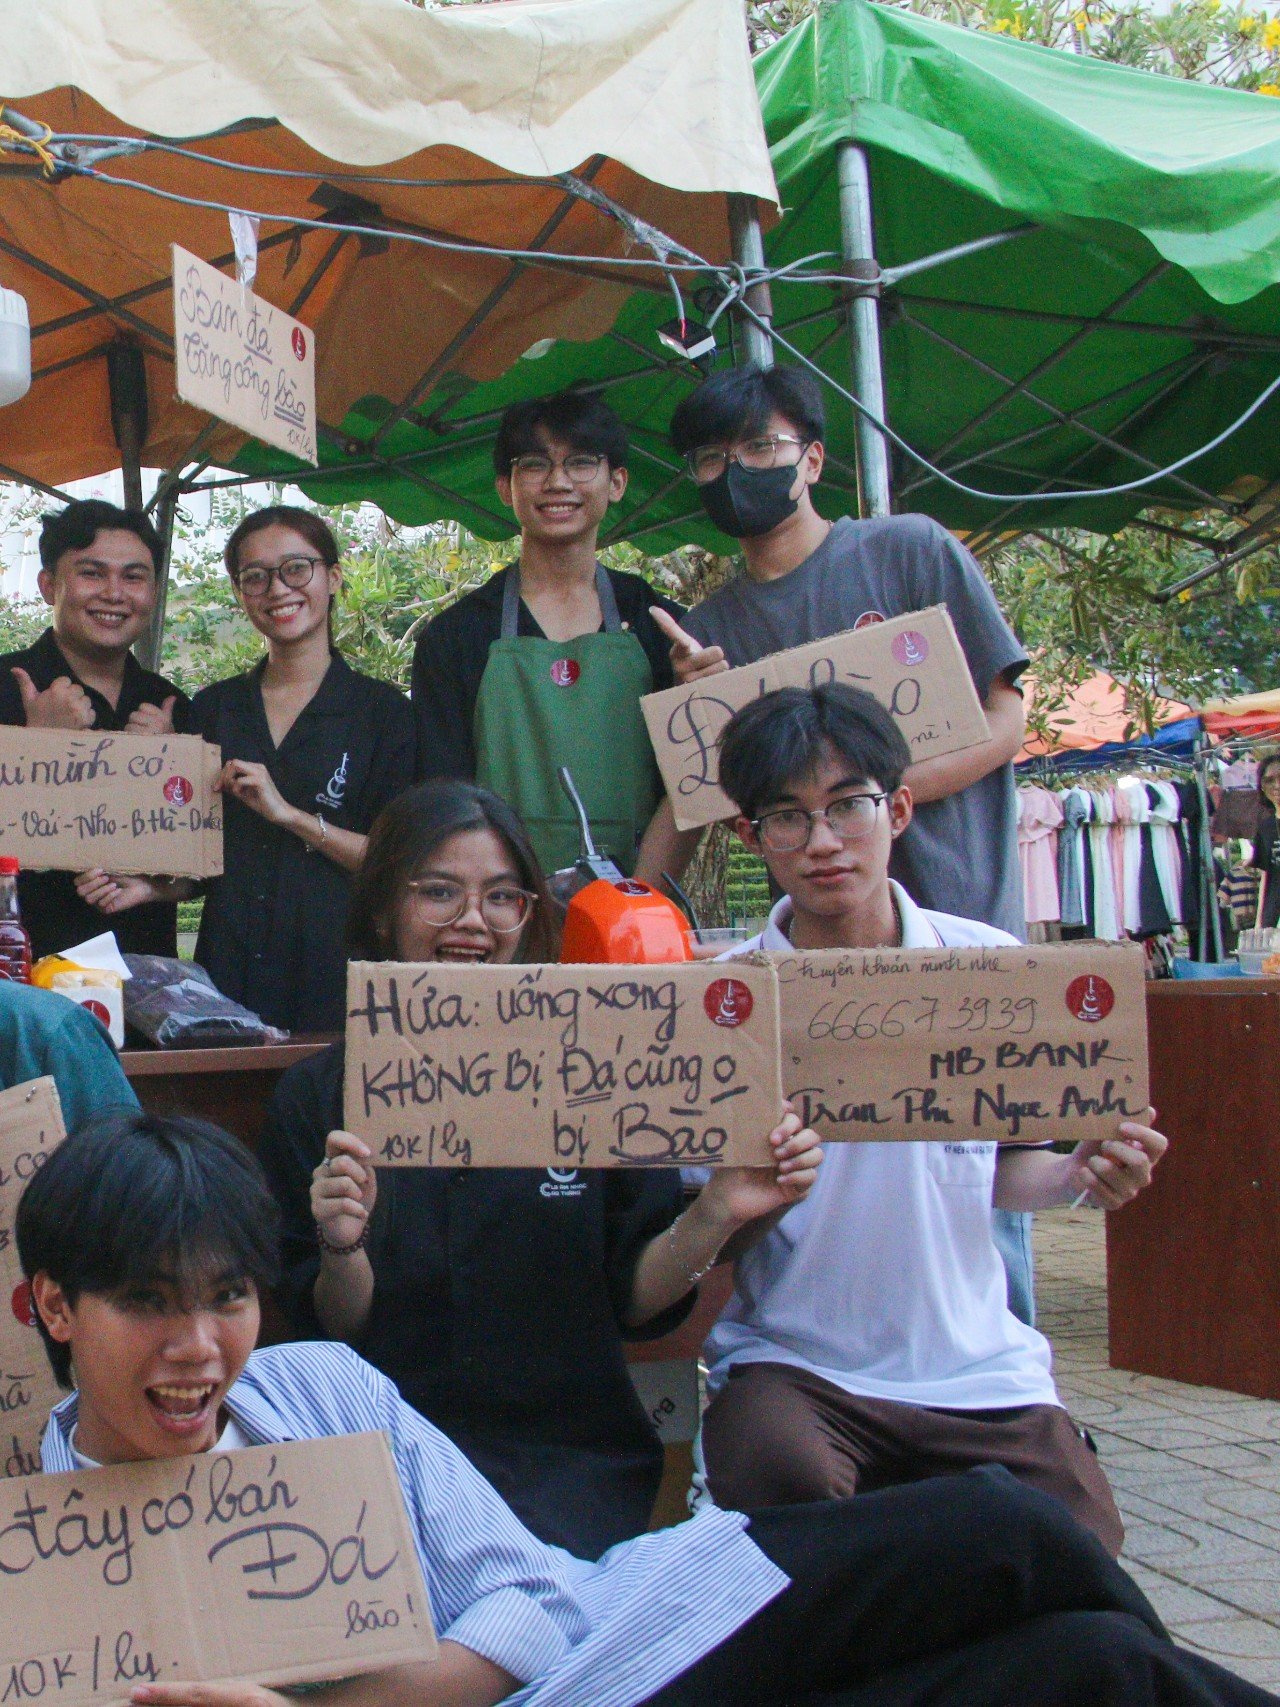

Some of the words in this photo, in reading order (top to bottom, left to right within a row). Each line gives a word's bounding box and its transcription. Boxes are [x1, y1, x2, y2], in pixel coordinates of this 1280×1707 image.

[624, 1043, 703, 1104] cũng
[929, 1046, 986, 1080] MB
[996, 1038, 1133, 1069] BANK
[141, 1463, 197, 1536] có
[206, 1454, 299, 1524] bán
[208, 1500, 400, 1600] Đá
